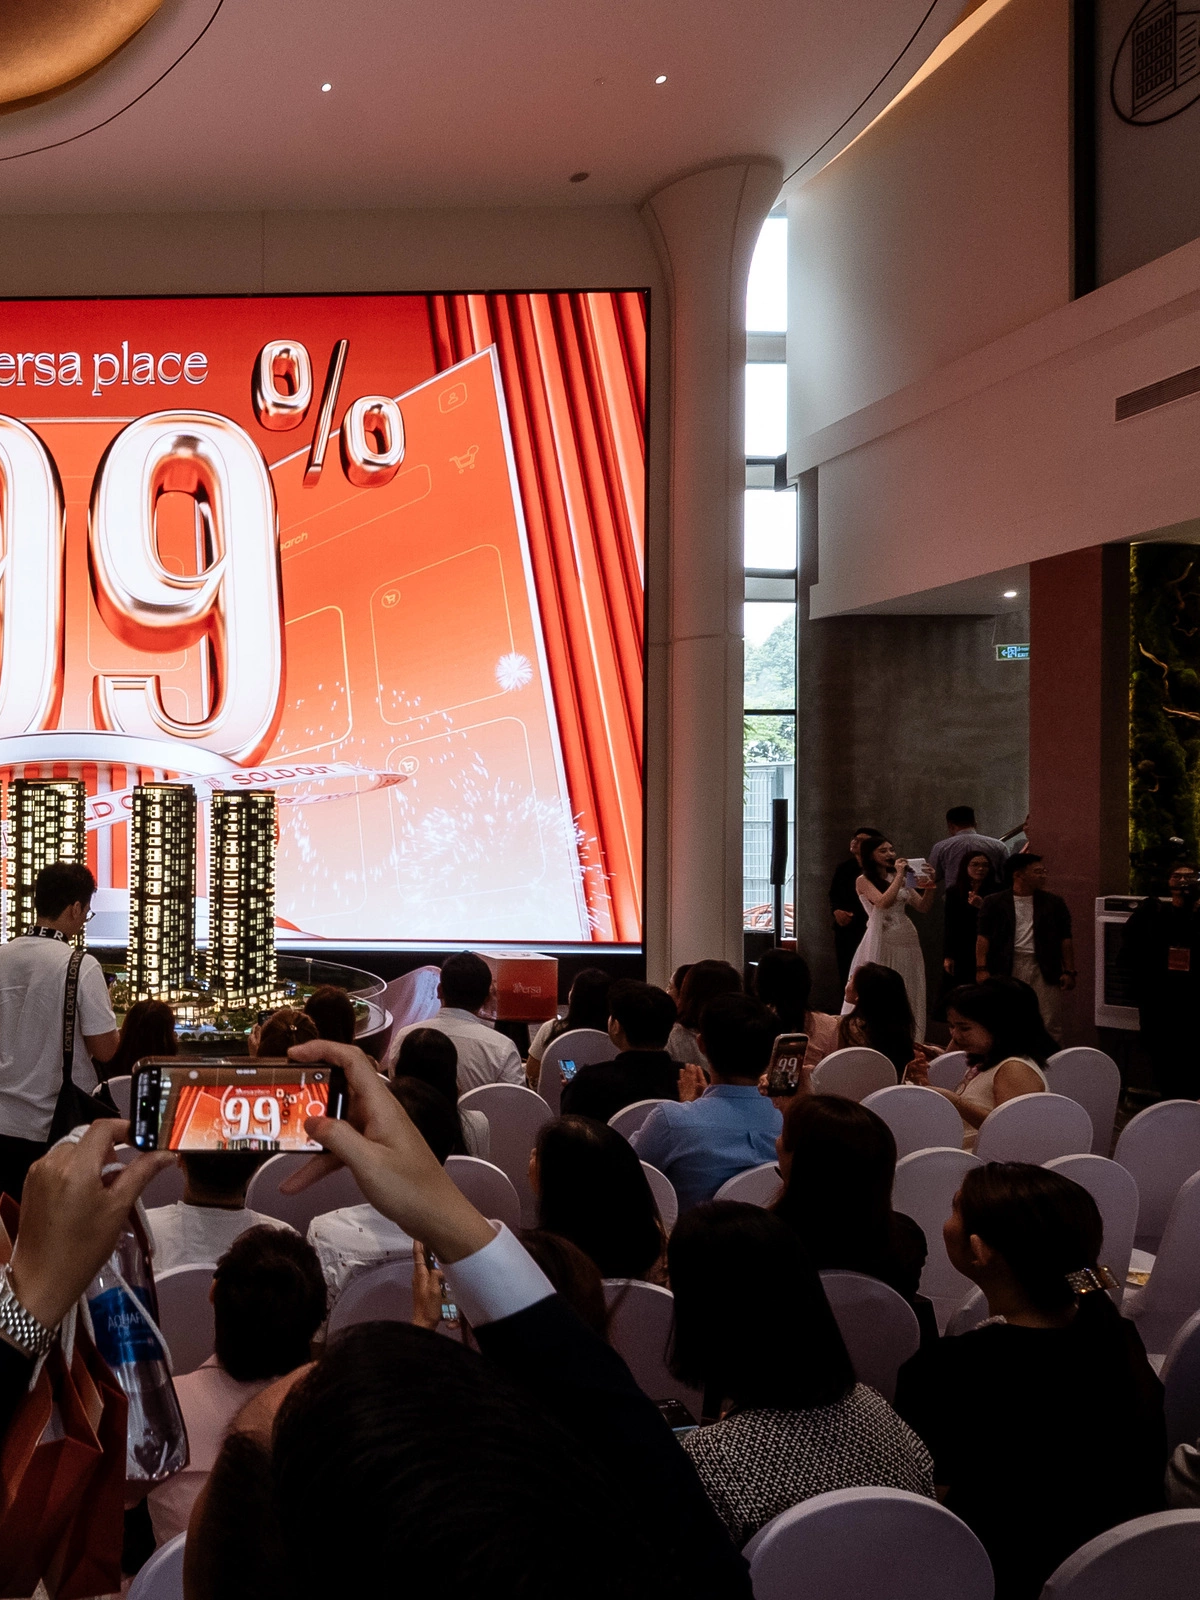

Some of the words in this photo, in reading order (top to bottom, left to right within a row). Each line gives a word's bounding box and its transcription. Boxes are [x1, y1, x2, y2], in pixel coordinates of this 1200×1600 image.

[91, 340, 209, 396] place
[232, 769, 296, 785] SOLD
[296, 765, 337, 776] OUT
[66, 983, 75, 1016] LOEWE
[64, 1019, 73, 1052] LOEWE
